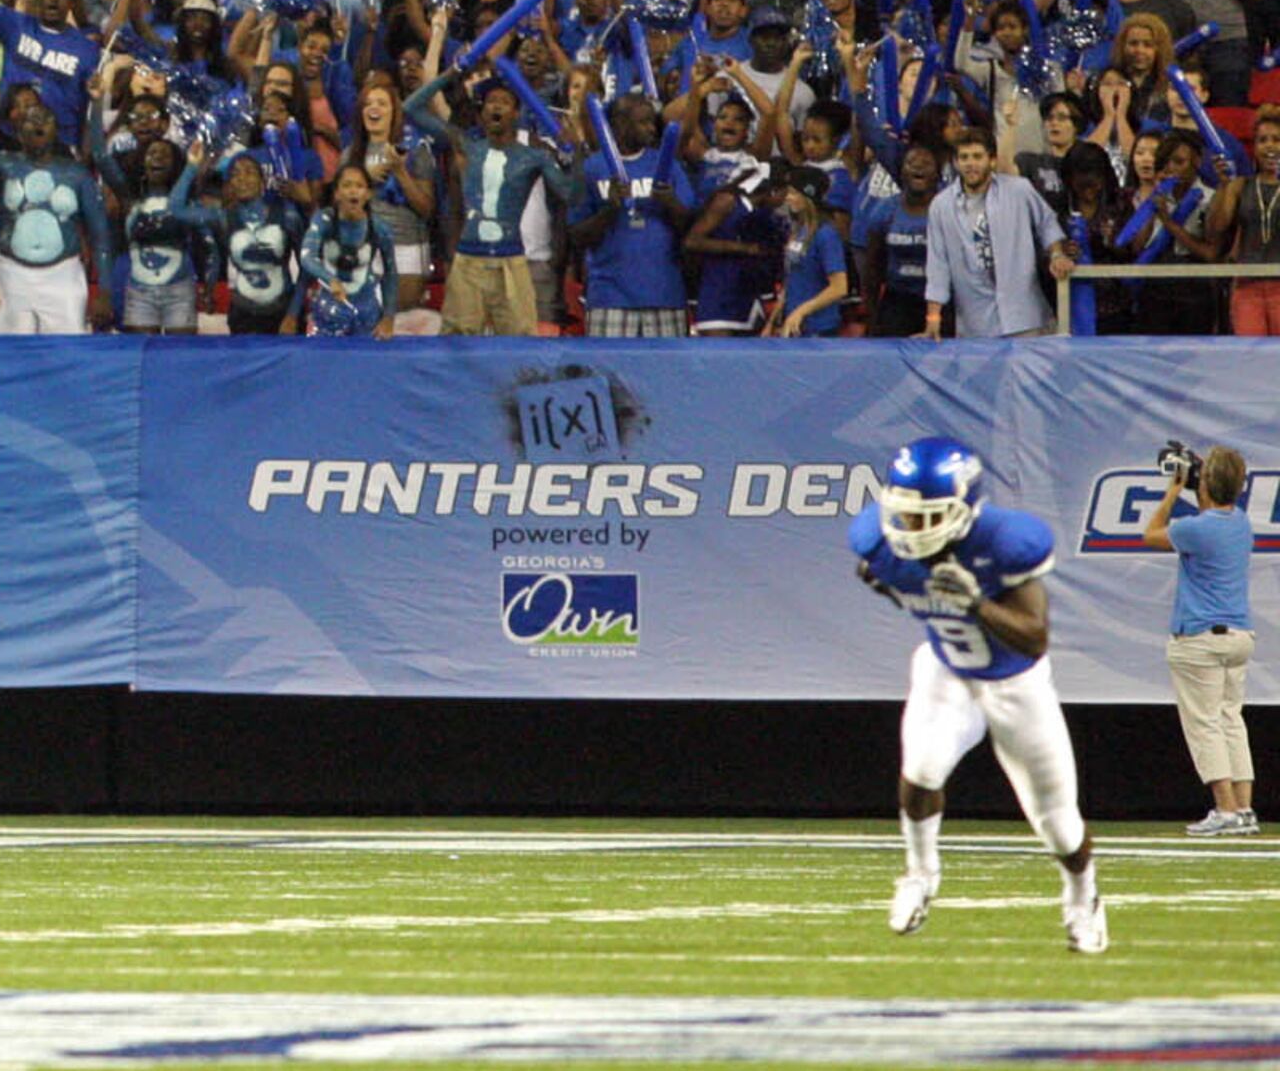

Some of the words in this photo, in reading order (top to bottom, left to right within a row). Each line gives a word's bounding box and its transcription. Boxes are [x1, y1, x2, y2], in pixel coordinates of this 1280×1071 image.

[18, 34, 42, 62] WE
[41, 50, 77, 76] ARE
[229, 224, 285, 305] S
[248, 459, 704, 518] PANTHERS
[491, 523, 610, 550] powered
[621, 523, 650, 551] by
[502, 555, 605, 569] GEORGIA'S
[502, 573, 638, 645] Own
[528, 647, 584, 657] CREDIT
[589, 647, 637, 658] UNION
[926, 617, 993, 669] 9
